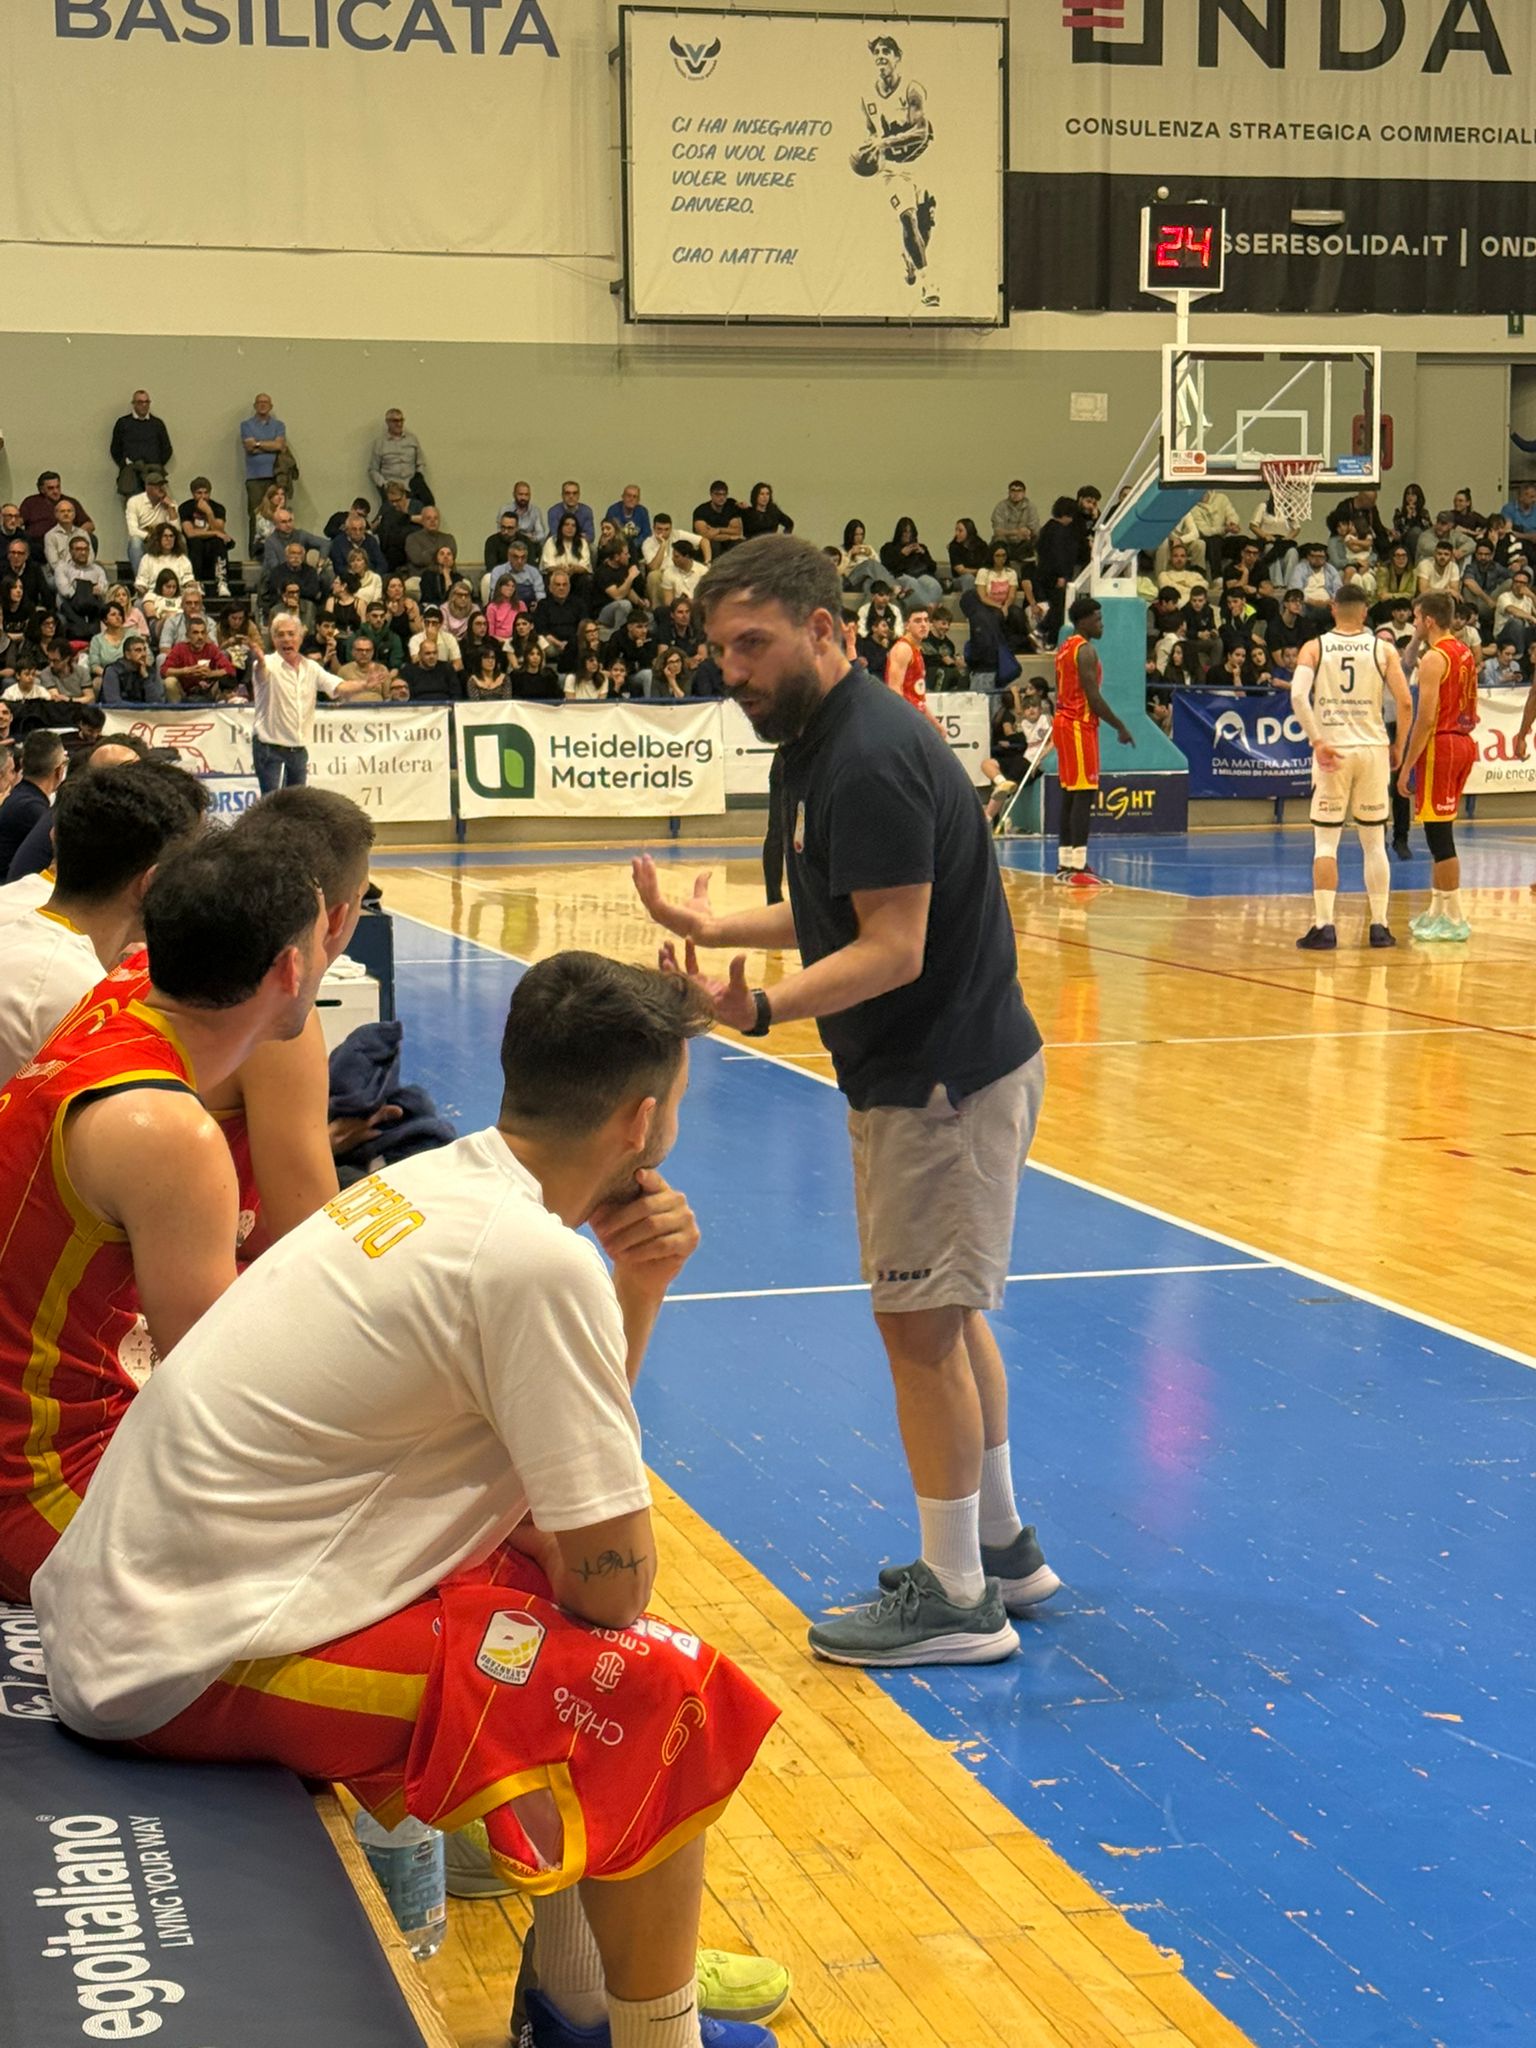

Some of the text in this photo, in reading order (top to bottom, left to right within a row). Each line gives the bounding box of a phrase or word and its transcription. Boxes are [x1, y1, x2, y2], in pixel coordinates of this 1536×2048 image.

[54, 0, 560, 58] BASILICATA
[671, 116, 833, 137] CI HAI INSEGNATO
[1065, 117, 1536, 145] CONSULENZA STRATEGICA COMMERCIAL
[671, 143, 819, 163] COSA VUOL DIRE
[671, 170, 797, 188] VOLER VIVERE
[671, 196, 754, 214] DAVVERO.
[672, 246, 799, 265] CIAO MATTIA!
[1157, 226, 1213, 268] 24
[1340, 657, 1355, 693] 5
[364, 722, 442, 744] Silvano
[550, 733, 713, 763] Heidelberg
[327, 756, 347, 776] di
[357, 755, 433, 775] Matera
[1212, 757, 1229, 767] DA
[1231, 758, 1280, 769] MATERA
[552, 763, 694, 789] Materials
[128, 1815, 195, 1948] LIVING YOUR WAY
[33, 1814, 186, 2040] egoitaliano
